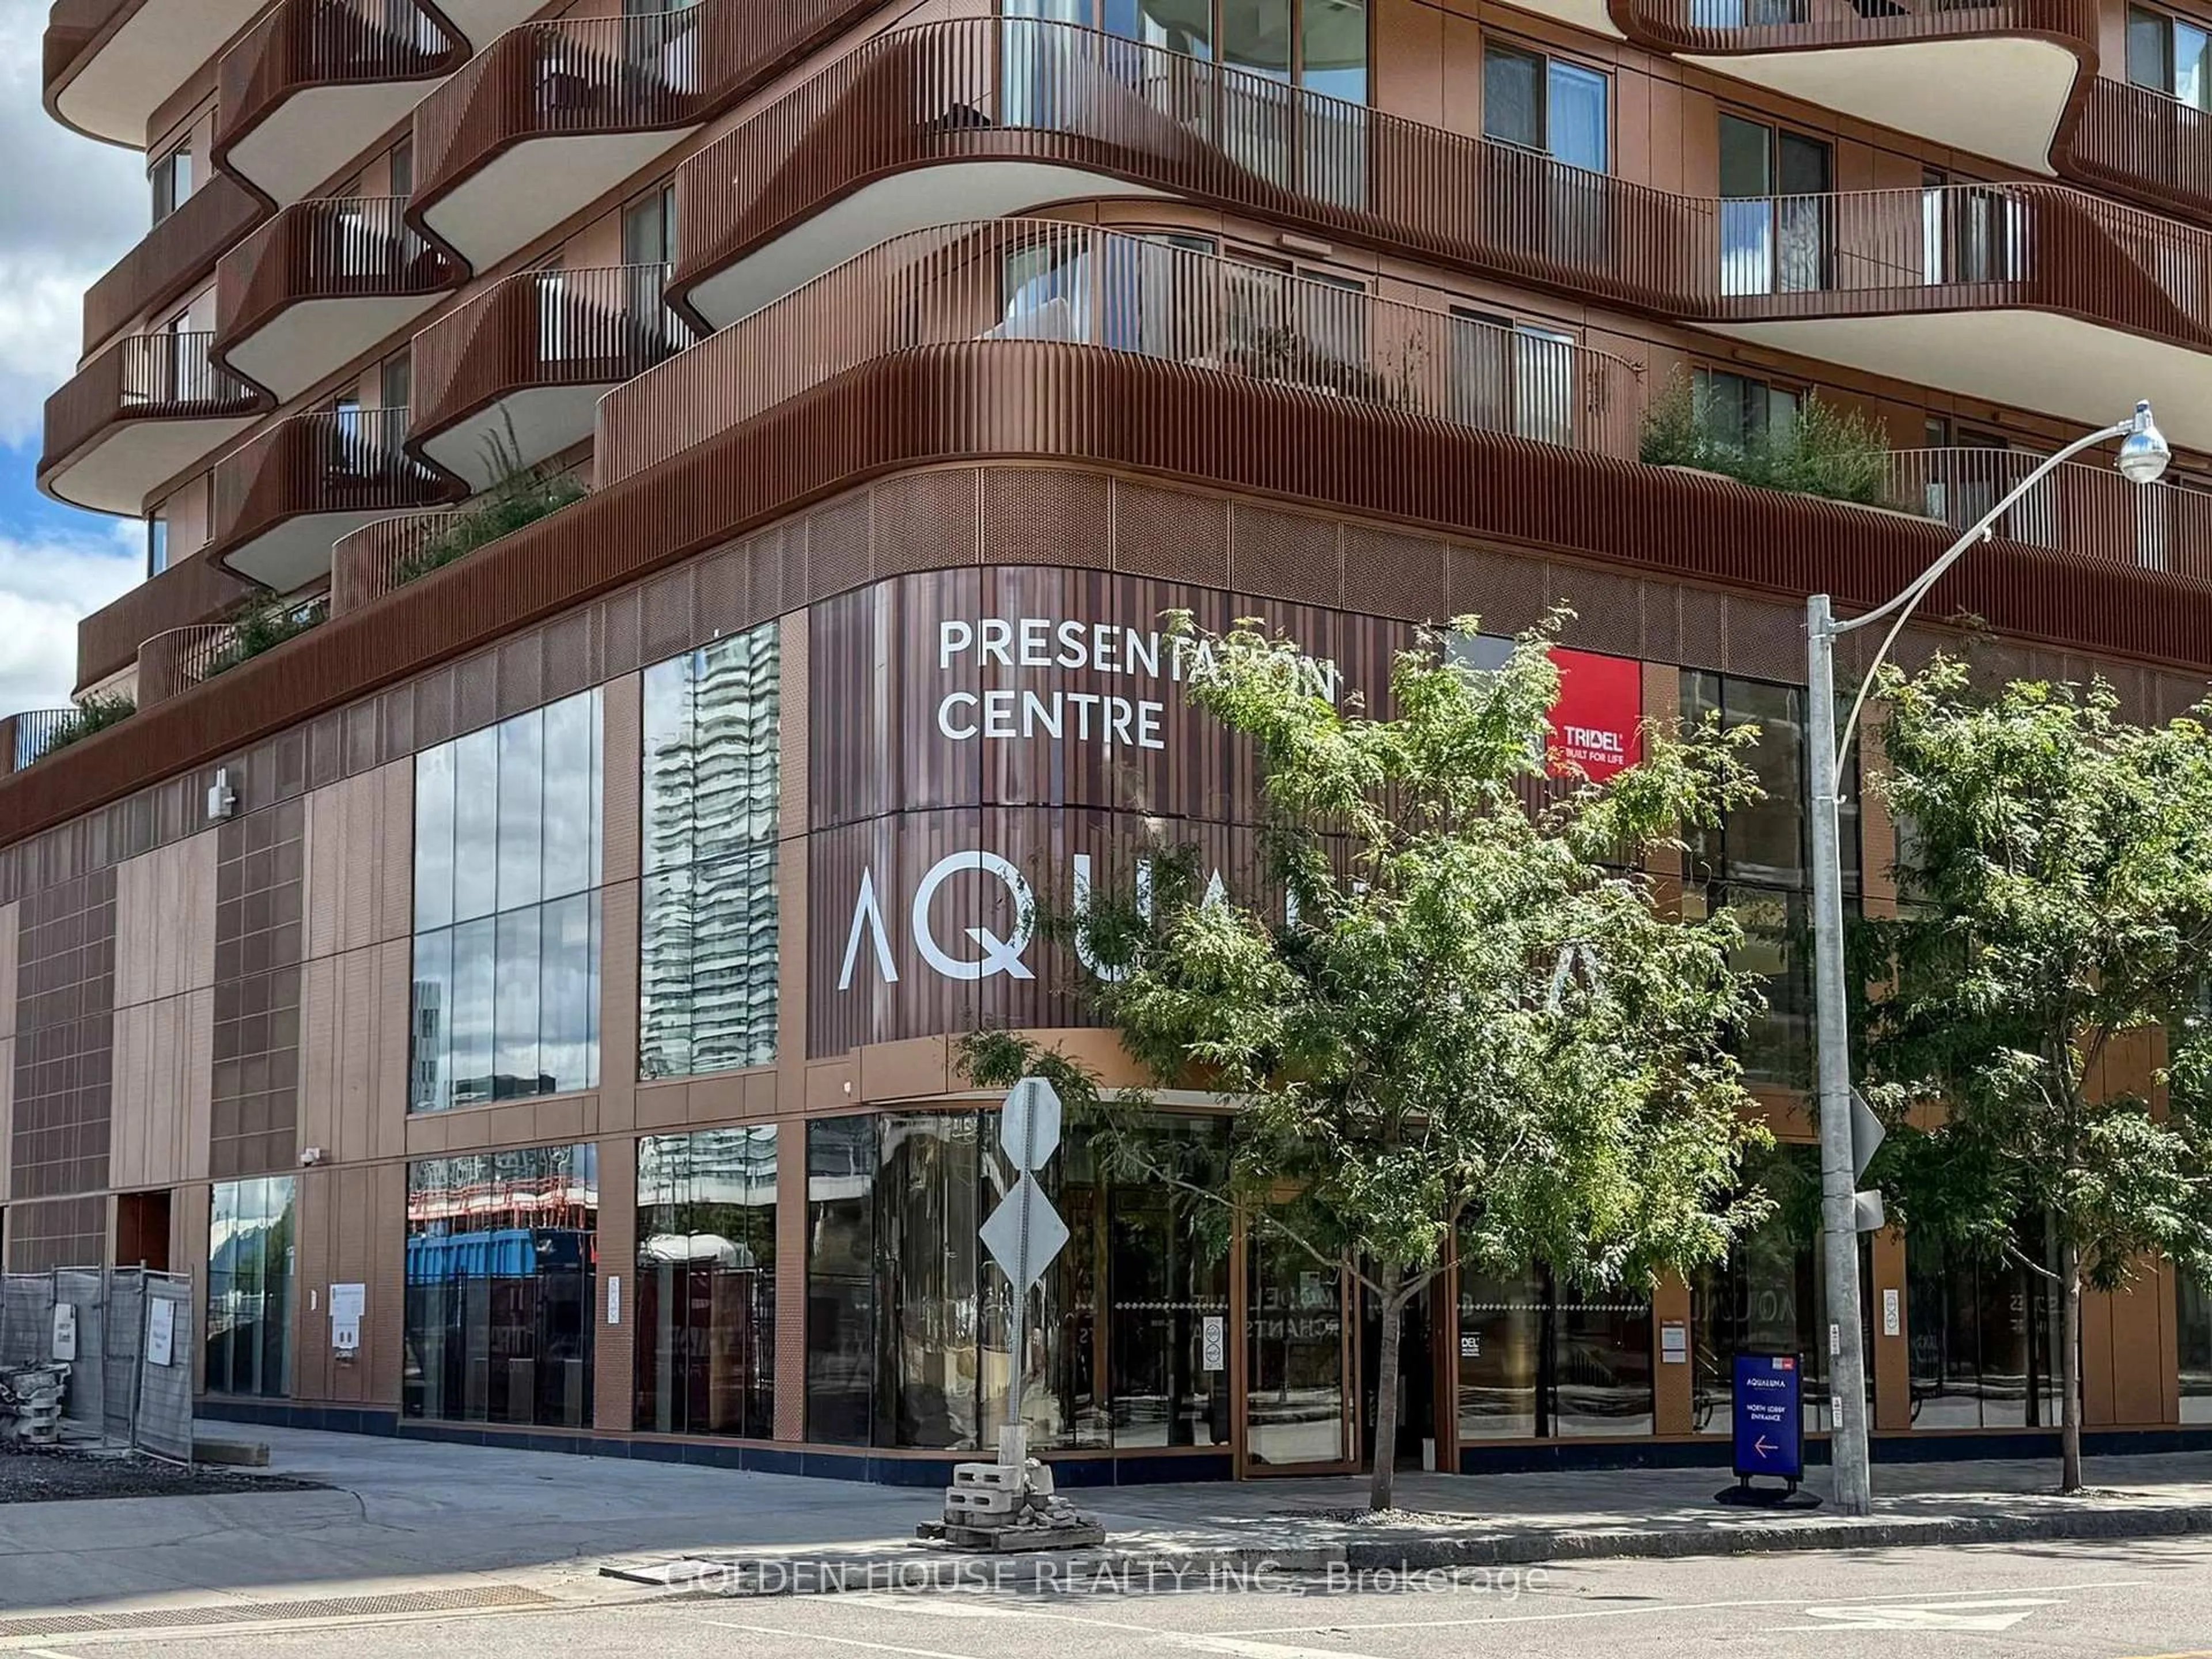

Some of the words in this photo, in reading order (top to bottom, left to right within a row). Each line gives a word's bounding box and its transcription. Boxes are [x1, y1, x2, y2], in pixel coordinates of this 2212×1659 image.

[937, 691, 1165, 749] CENTRE
[1563, 726, 1623, 752] TRIDEL
[1589, 751, 1606, 763] FOR
[1607, 753, 1624, 765] LIFE
